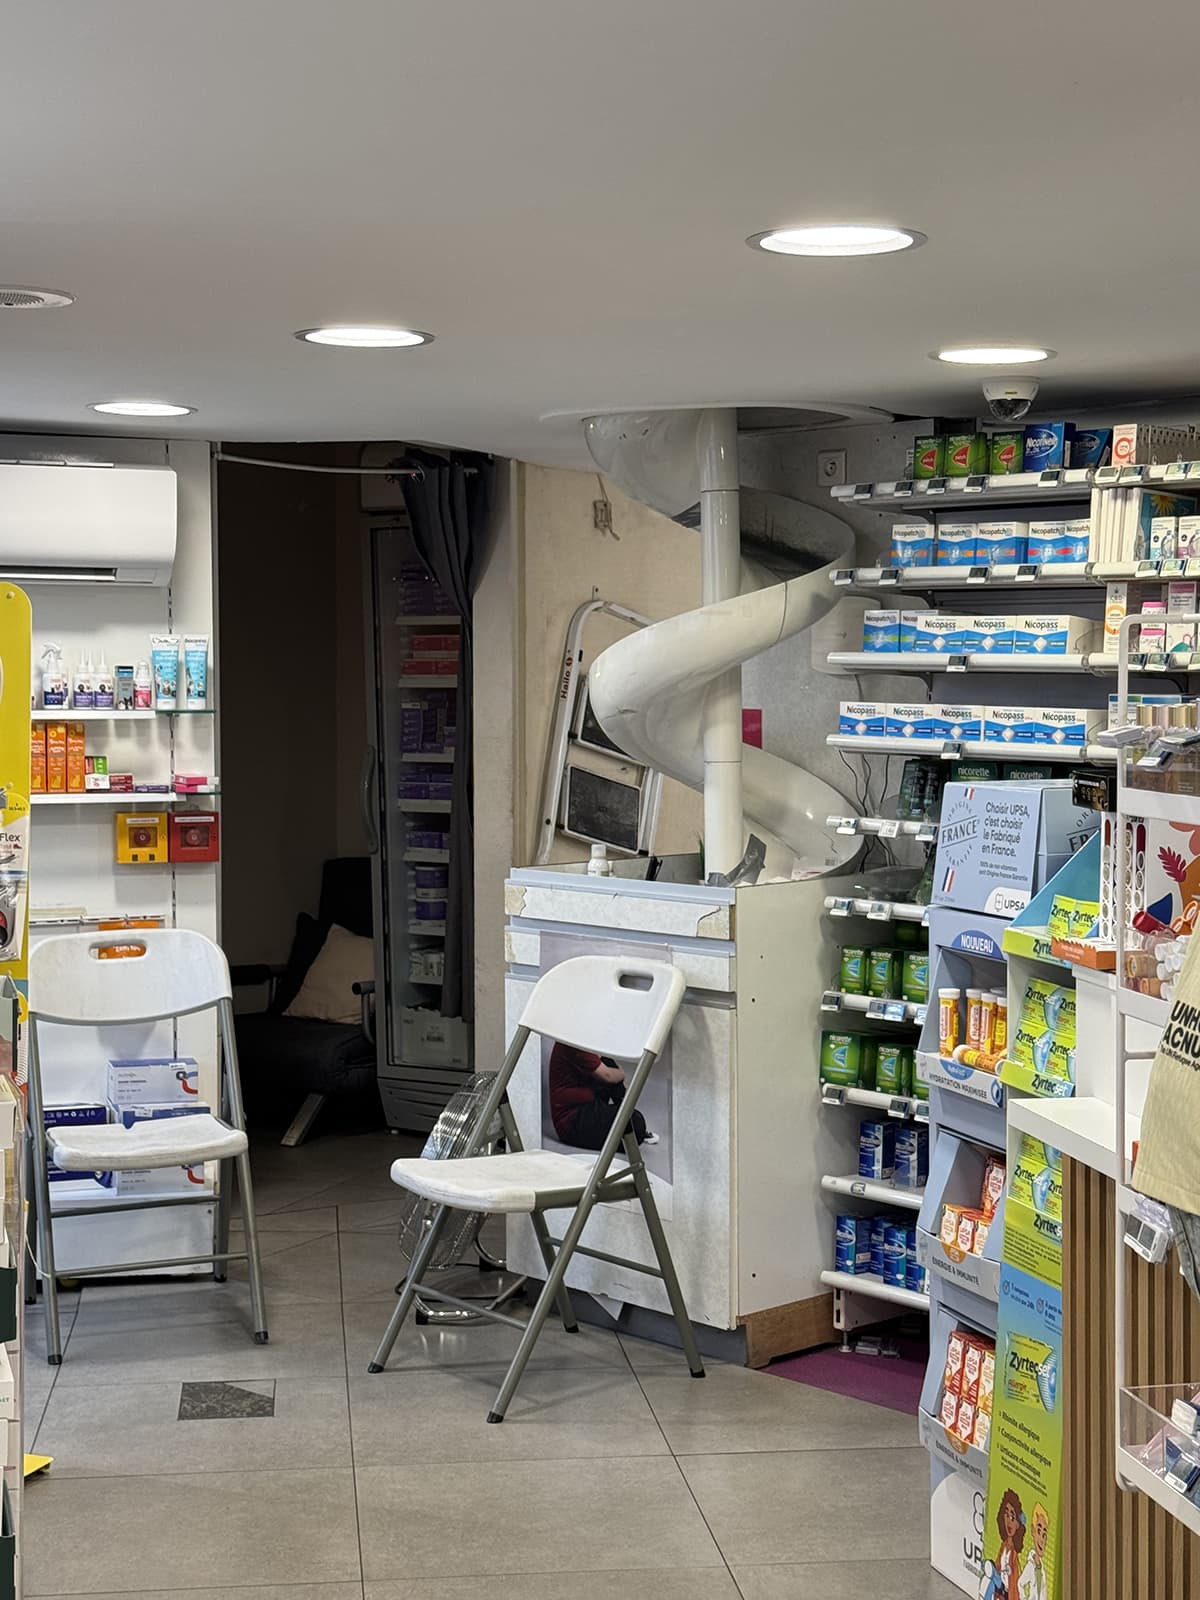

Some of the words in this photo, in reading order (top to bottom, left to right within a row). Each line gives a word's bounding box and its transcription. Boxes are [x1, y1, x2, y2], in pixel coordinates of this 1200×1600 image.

[924, 620, 957, 630] Nicopass
[973, 619, 1006, 630] Nicopass
[1024, 620, 1059, 631] Nicopass
[560, 669, 572, 699] Hailo
[846, 706, 876, 715] Nicopass
[893, 706, 924, 718] Nicopass
[941, 708, 972, 719] Nicopass
[992, 710, 1025, 721] Nicopass
[1042, 711, 1076, 724] Nicopass
[957, 766, 990, 778] nicorette
[986, 802, 1009, 814] Choisir
[1010, 804, 1030, 818] UPSA,
[984, 816, 999, 827] c'est
[1000, 818, 1023, 830] choisir
[942, 820, 977, 844] FRANCE
[983, 829, 990, 840] le
[991, 830, 1021, 845] Fabriqué
[982, 845, 991, 853] en
[992, 844, 1016, 857] France.
[1004, 899, 1025, 911] UPSA
[960, 934, 994, 954] NOUVEAU
[1032, 1074, 1068, 1096] Zyrtecset
